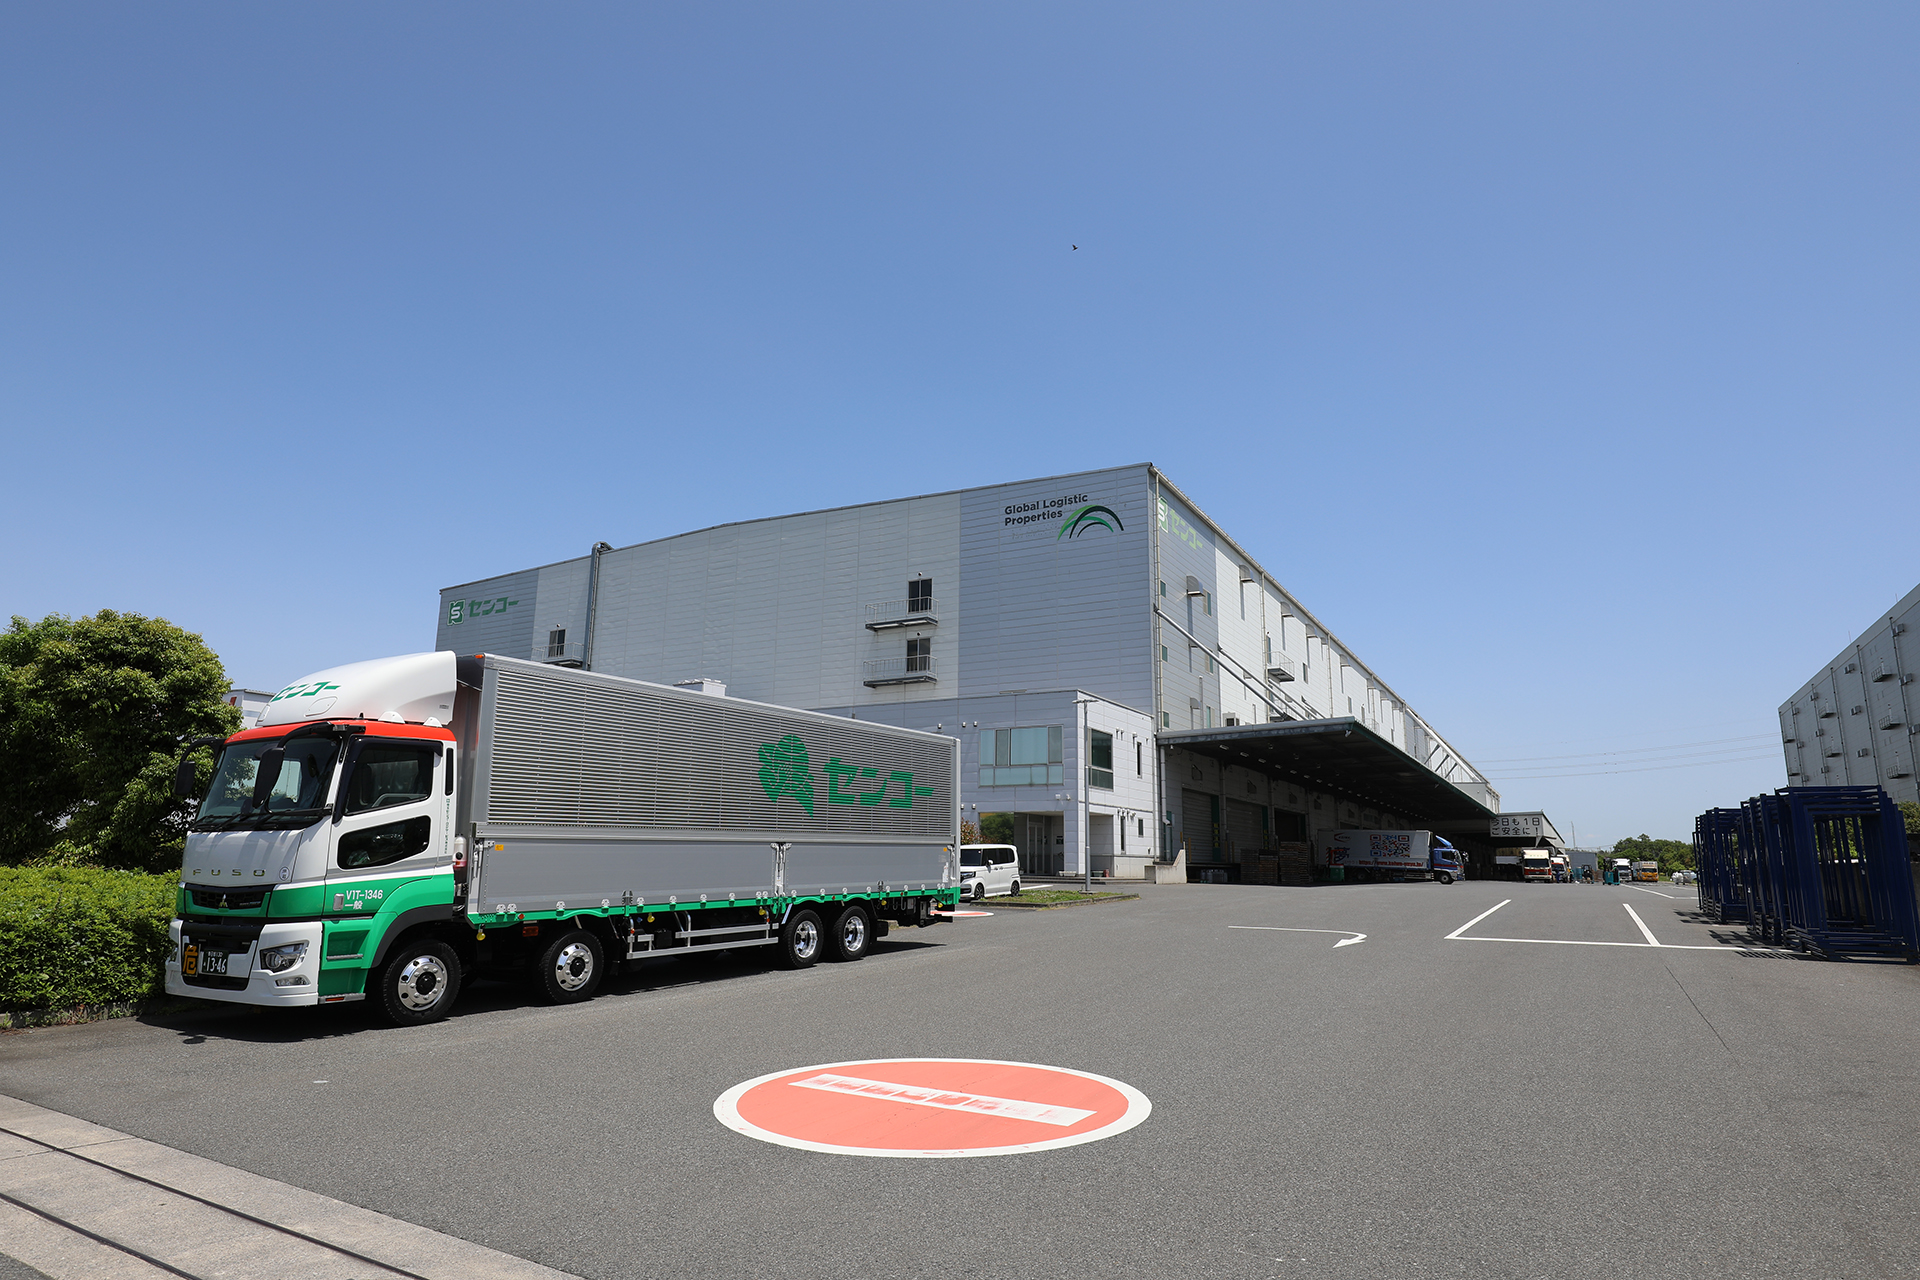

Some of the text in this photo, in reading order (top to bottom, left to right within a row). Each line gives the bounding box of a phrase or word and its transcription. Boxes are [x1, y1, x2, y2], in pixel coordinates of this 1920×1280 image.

[1005, 494, 1088, 515] Global Logistic
[1005, 510, 1063, 526] Properties
[1170, 509, 1203, 550] センコー
[468, 597, 519, 617] センコー
[270, 681, 341, 702] センコー
[822, 757, 935, 809] センコー
[193, 868, 266, 877] FUSO
[344, 900, 363, 910] 一般
[183, 945, 198, 974] 危
